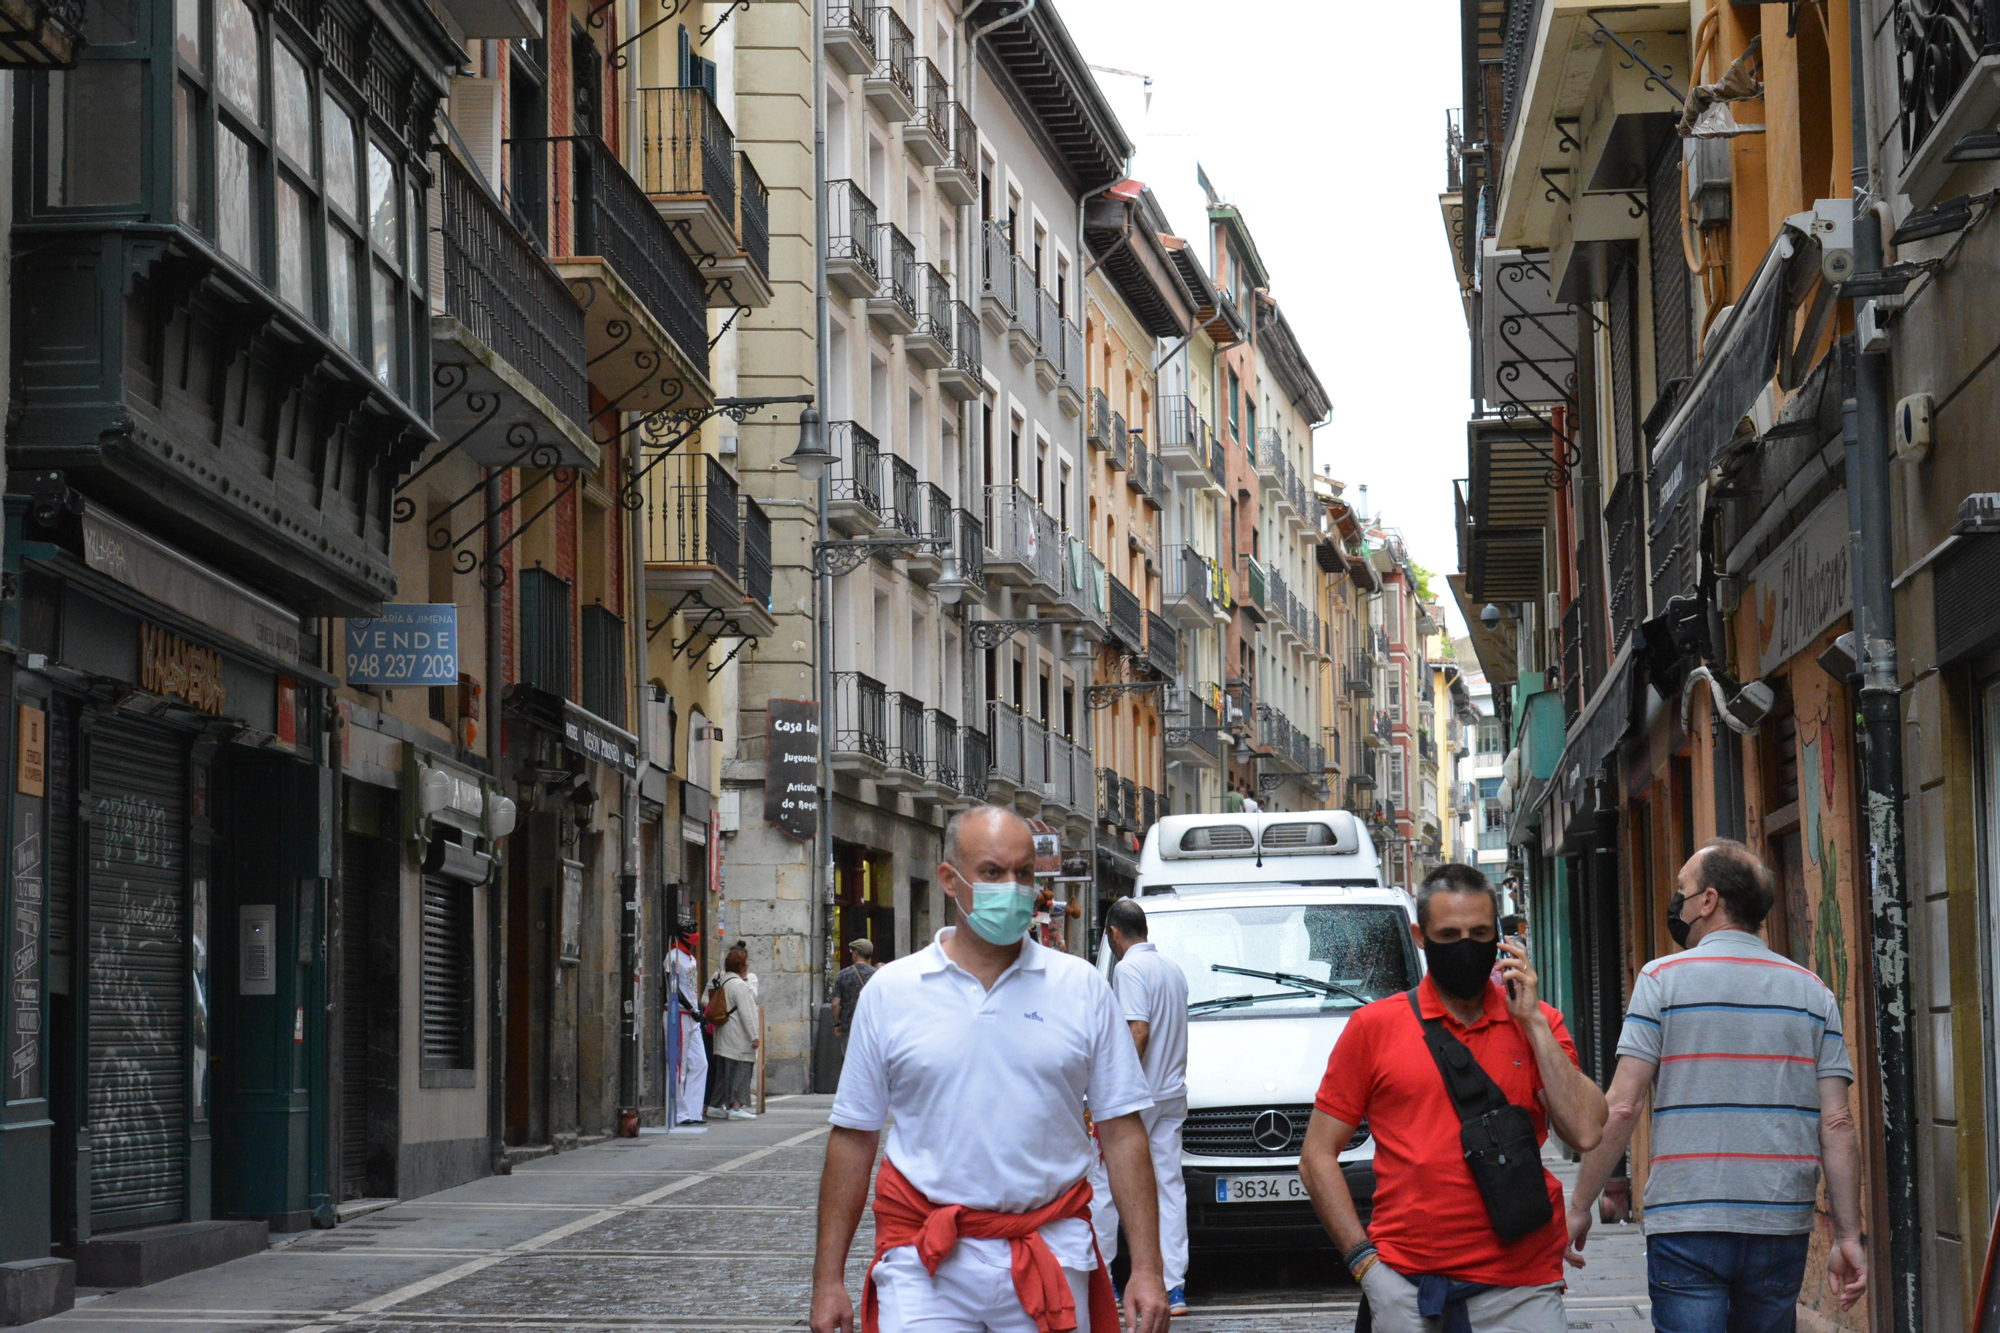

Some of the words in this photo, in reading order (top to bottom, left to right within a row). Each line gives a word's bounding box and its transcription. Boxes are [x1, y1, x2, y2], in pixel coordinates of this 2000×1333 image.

[1780, 543, 1796, 657] El
[1796, 542, 1847, 646] Mexicano
[406, 615, 414, 624] &
[416, 615, 454, 624] JIMENA
[352, 631, 449, 649] VENDE
[347, 653, 380, 678] 948
[385, 654, 417, 678] 237
[422, 654, 455, 678] 203
[775, 719, 802, 734] Casa
[781, 798, 795, 809] de
[1233, 1180, 1280, 1199] 3634
